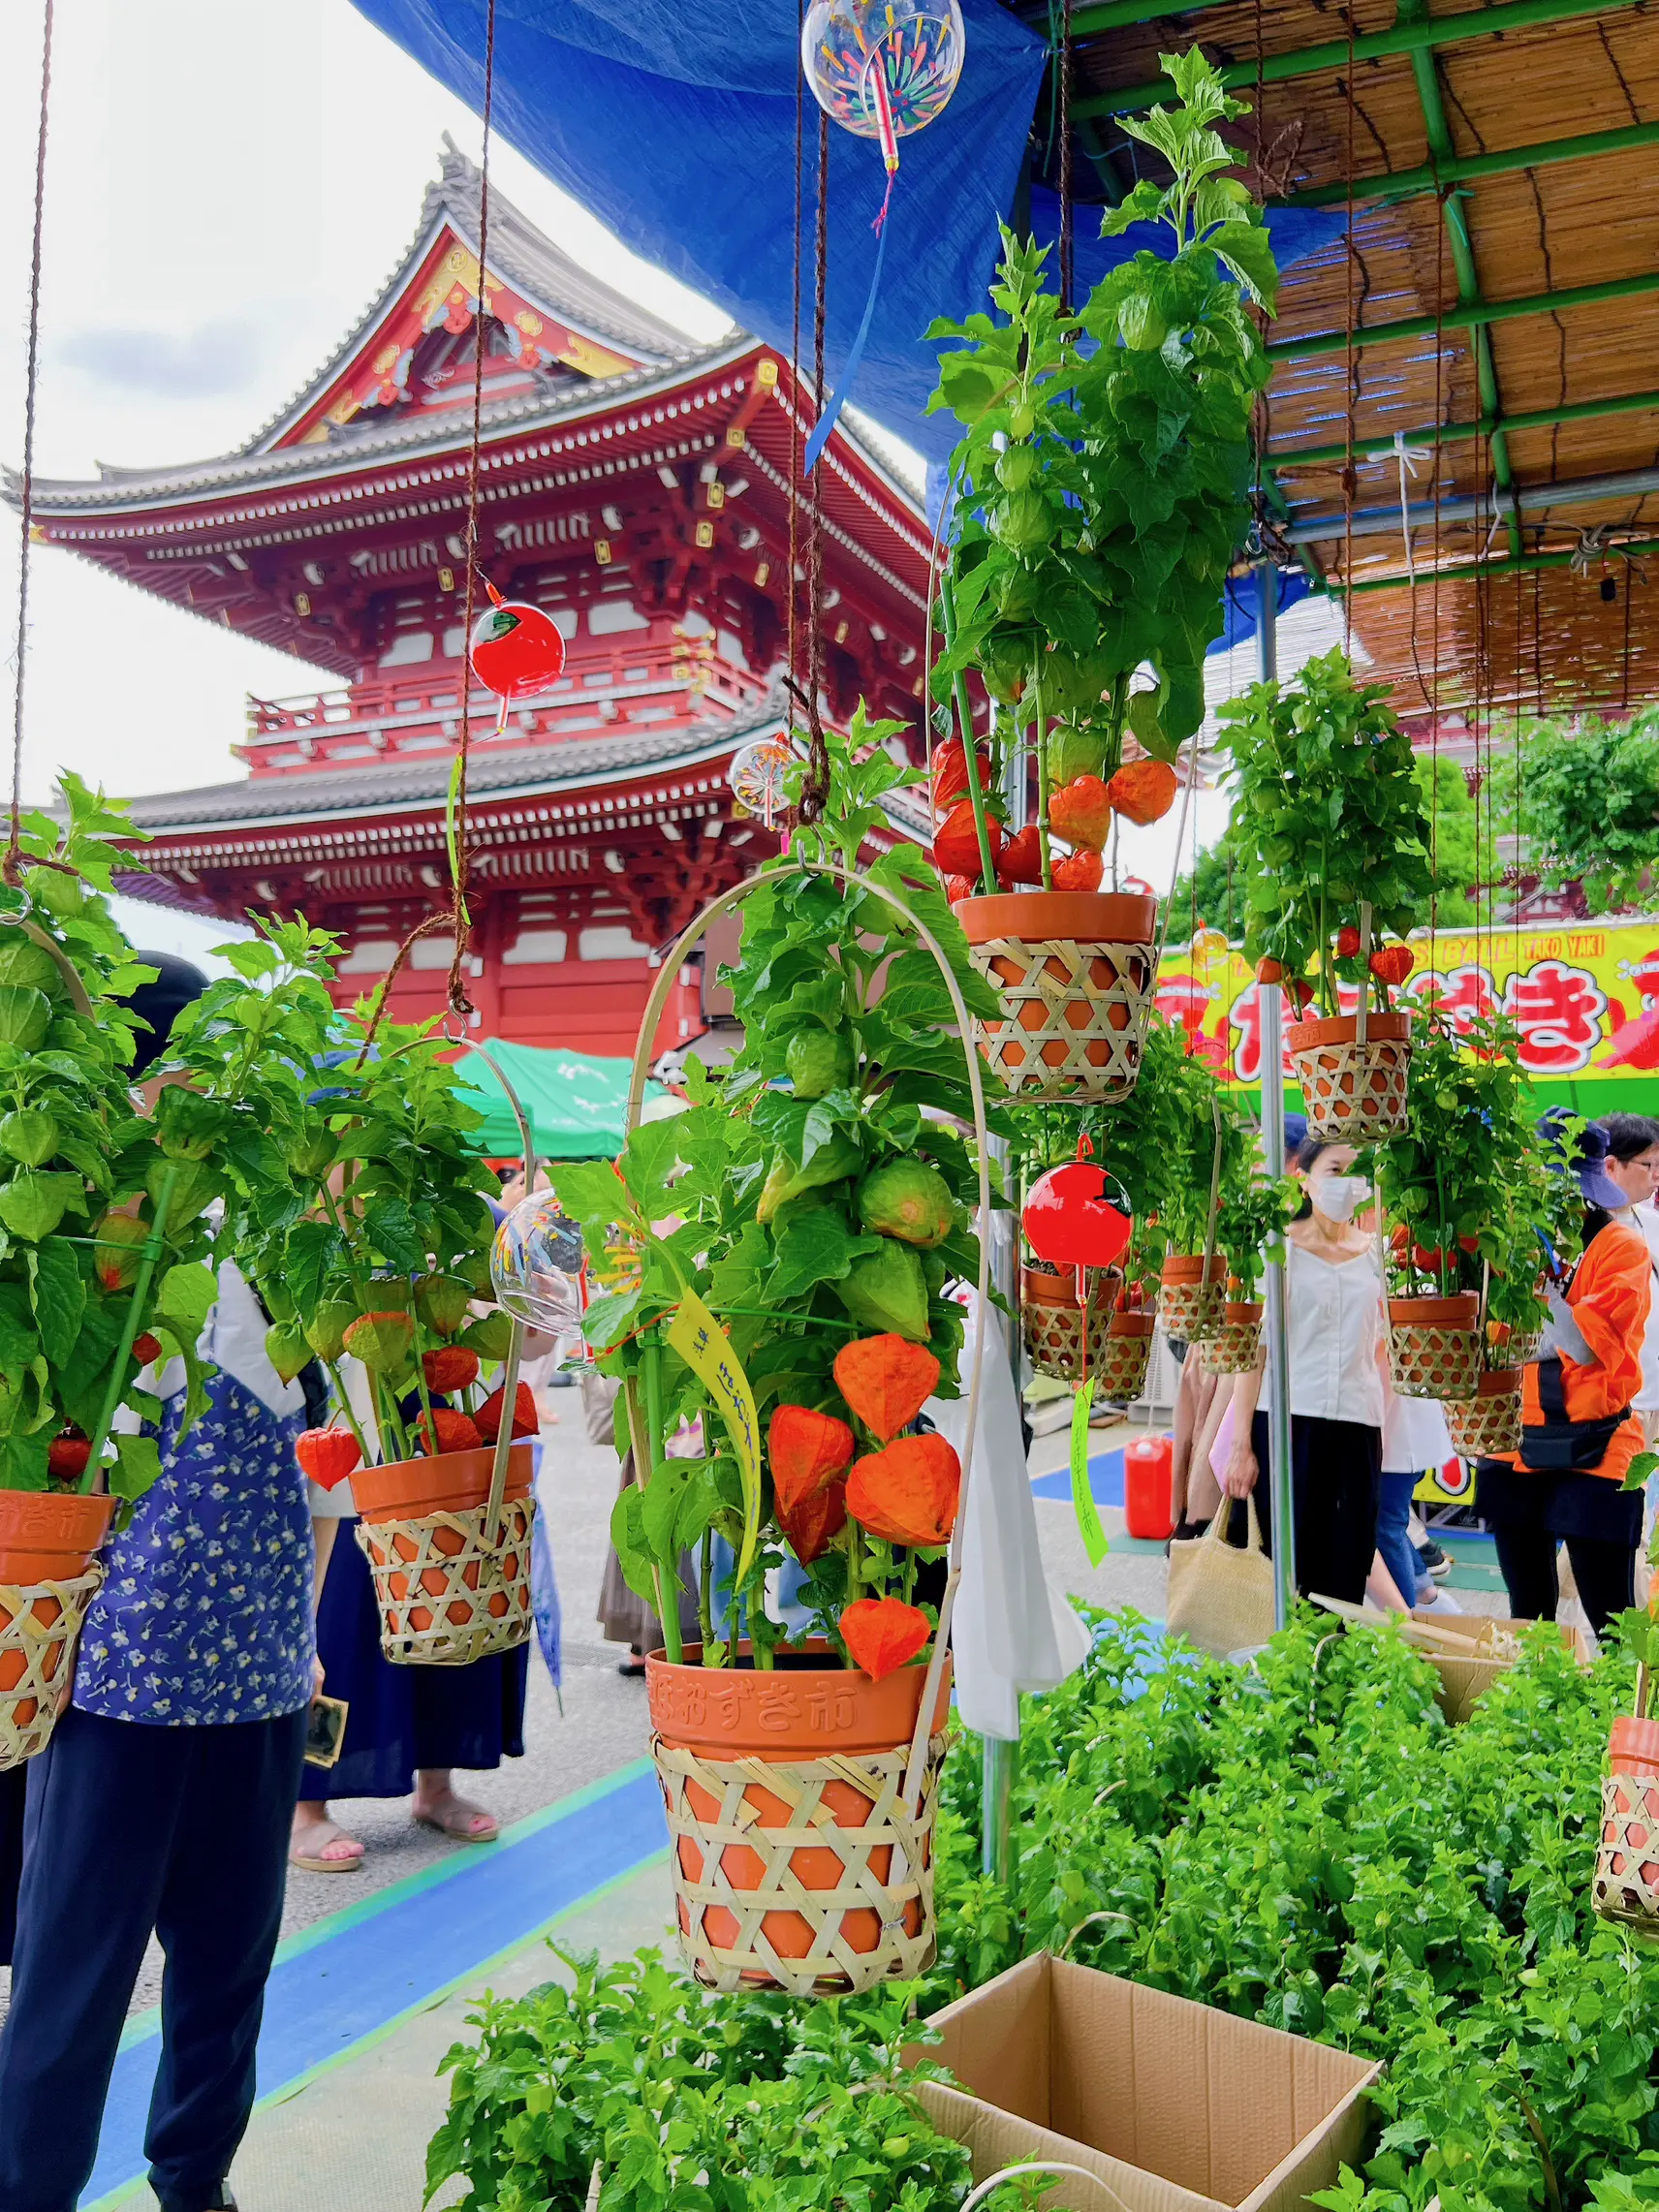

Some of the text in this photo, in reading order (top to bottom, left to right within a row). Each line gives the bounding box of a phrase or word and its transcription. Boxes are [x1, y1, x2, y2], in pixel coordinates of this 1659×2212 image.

[1443, 935, 1516, 965] BALL
[1522, 935, 1562, 959] TAKO
[1568, 933, 1605, 958] YAKI
